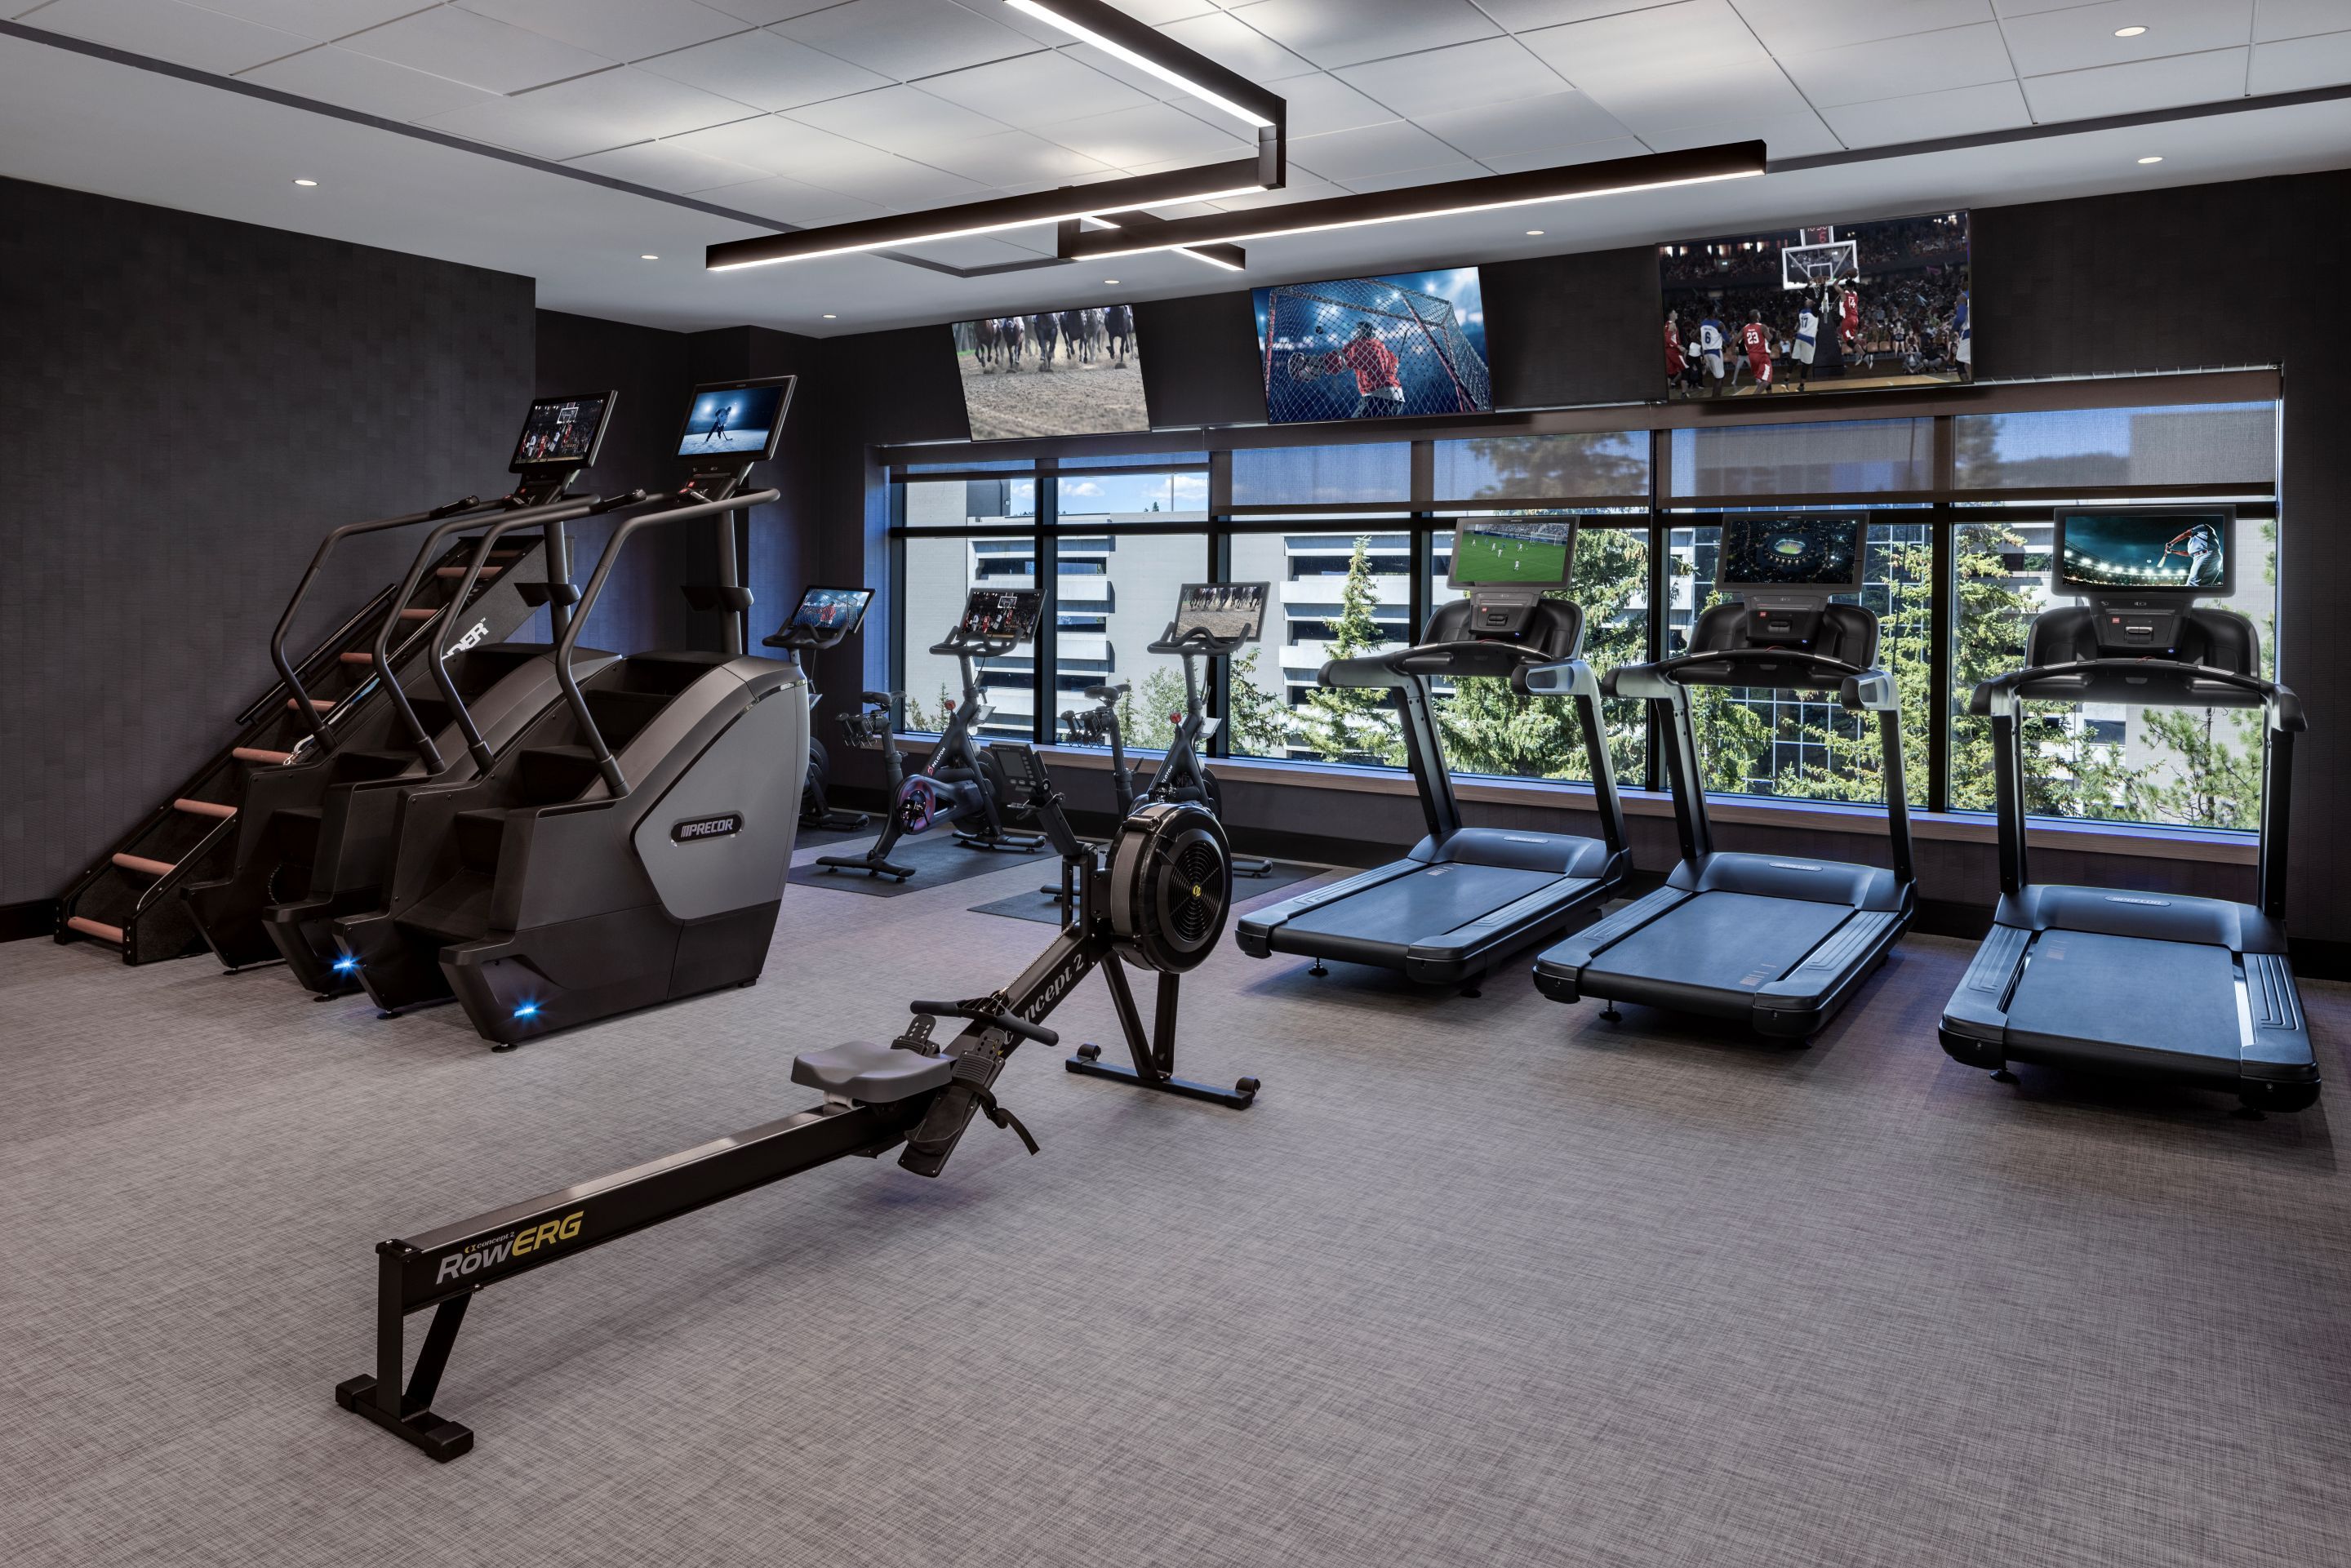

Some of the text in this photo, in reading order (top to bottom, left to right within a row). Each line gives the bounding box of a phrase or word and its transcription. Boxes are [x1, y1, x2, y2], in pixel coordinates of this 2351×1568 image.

[1704, 331, 1711, 344] 6
[1747, 331, 1760, 344] 23
[931, 747, 946, 768] PELOTON
[682, 819, 734, 837] PRECOR
[1003, 953, 1084, 1045] cncept 2
[477, 1233, 509, 1249] concept
